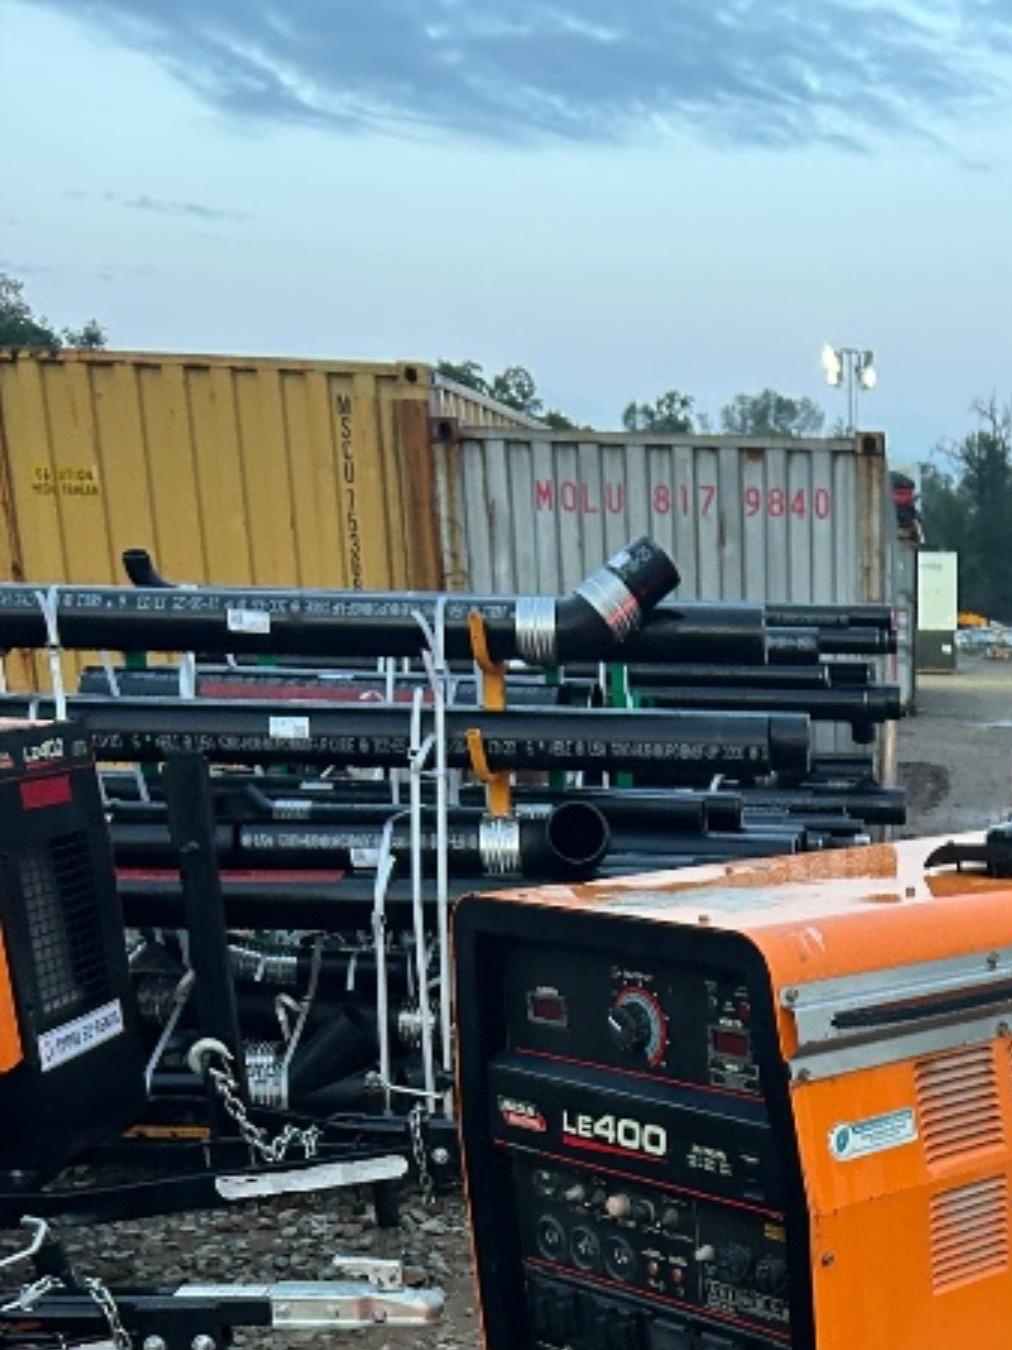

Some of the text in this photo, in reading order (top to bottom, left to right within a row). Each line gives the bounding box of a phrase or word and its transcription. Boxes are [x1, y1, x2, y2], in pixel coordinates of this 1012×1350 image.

[533, 479, 832, 520] MOLU 817 9840
[562, 1109, 667, 1157] LE400
